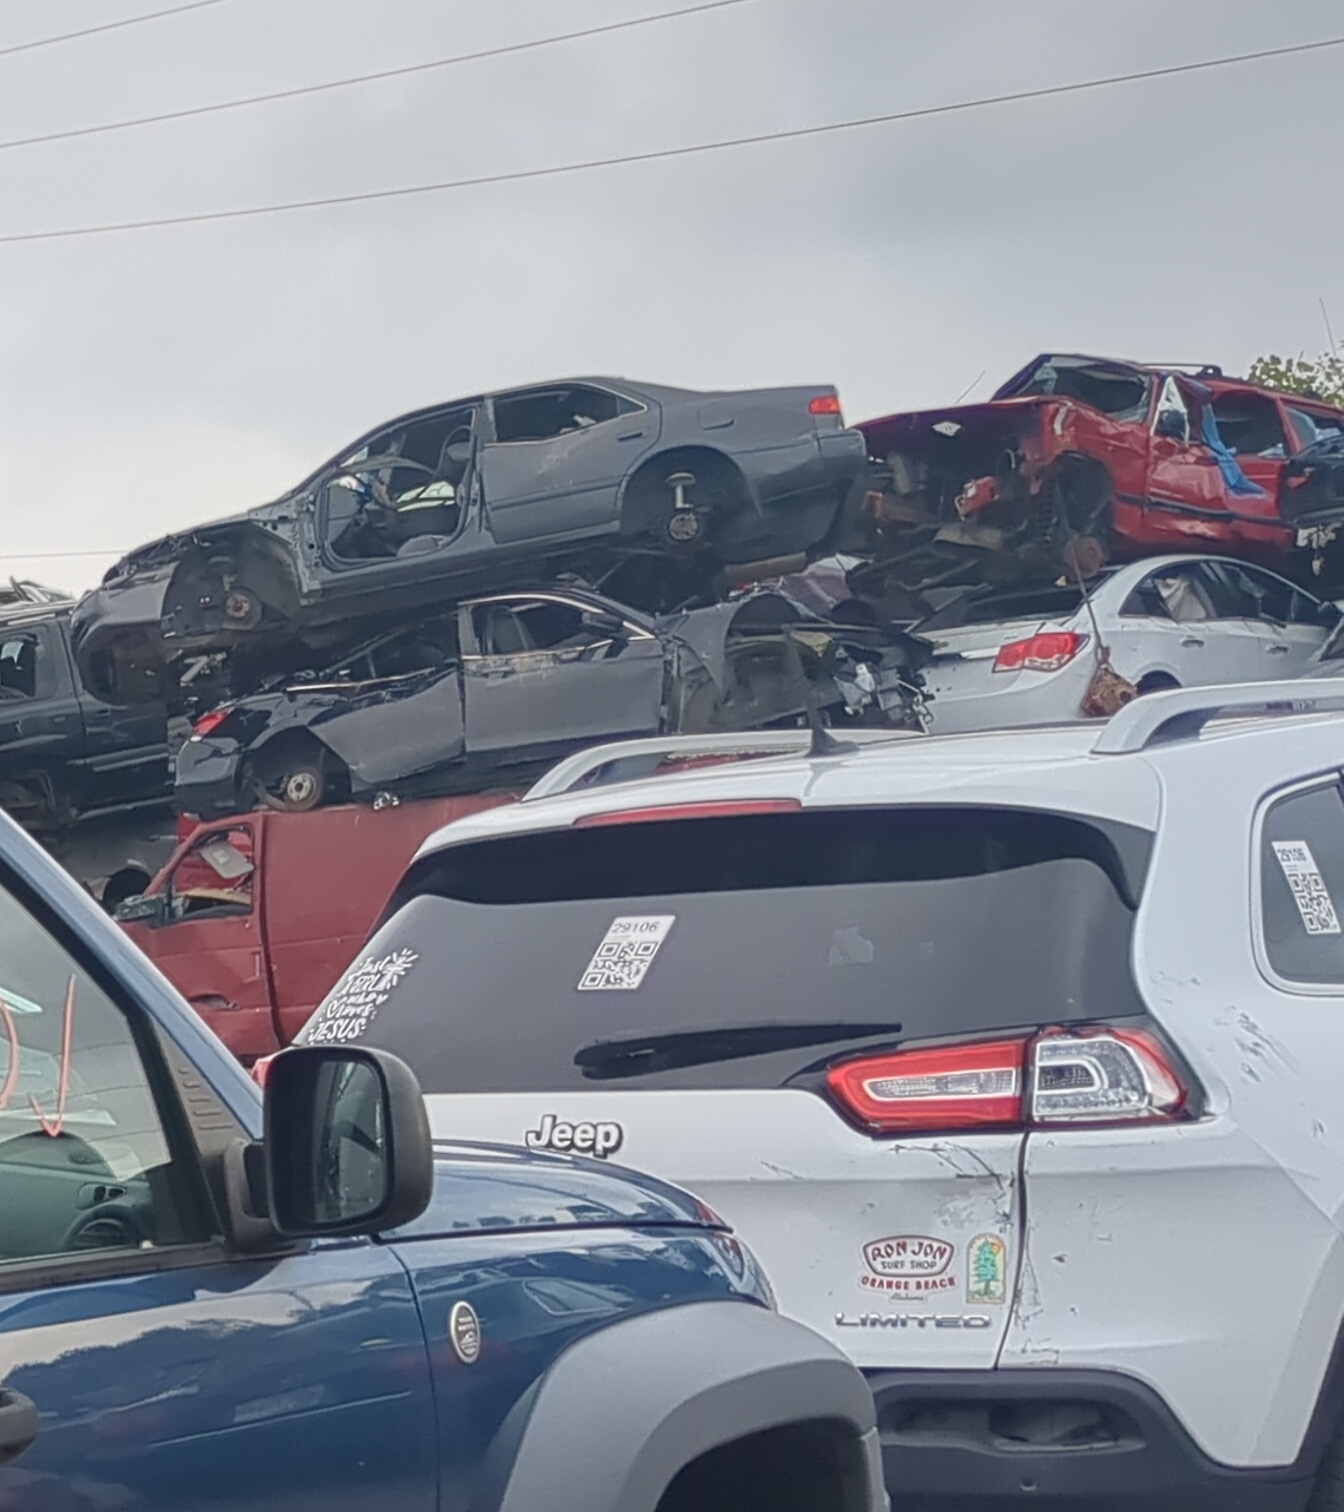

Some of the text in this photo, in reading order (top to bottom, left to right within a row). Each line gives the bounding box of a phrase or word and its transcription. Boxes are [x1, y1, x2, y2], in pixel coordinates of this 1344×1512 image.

[611, 921, 660, 934] 29106
[308, 1018, 366, 1042] JESUS
[525, 1114, 623, 1159] Jeep
[871, 1241, 948, 1262] RON JON
[880, 1260, 937, 1270] SURF SHOP
[861, 1276, 910, 1290] ORANGE
[834, 1312, 992, 1329] LIMITED
